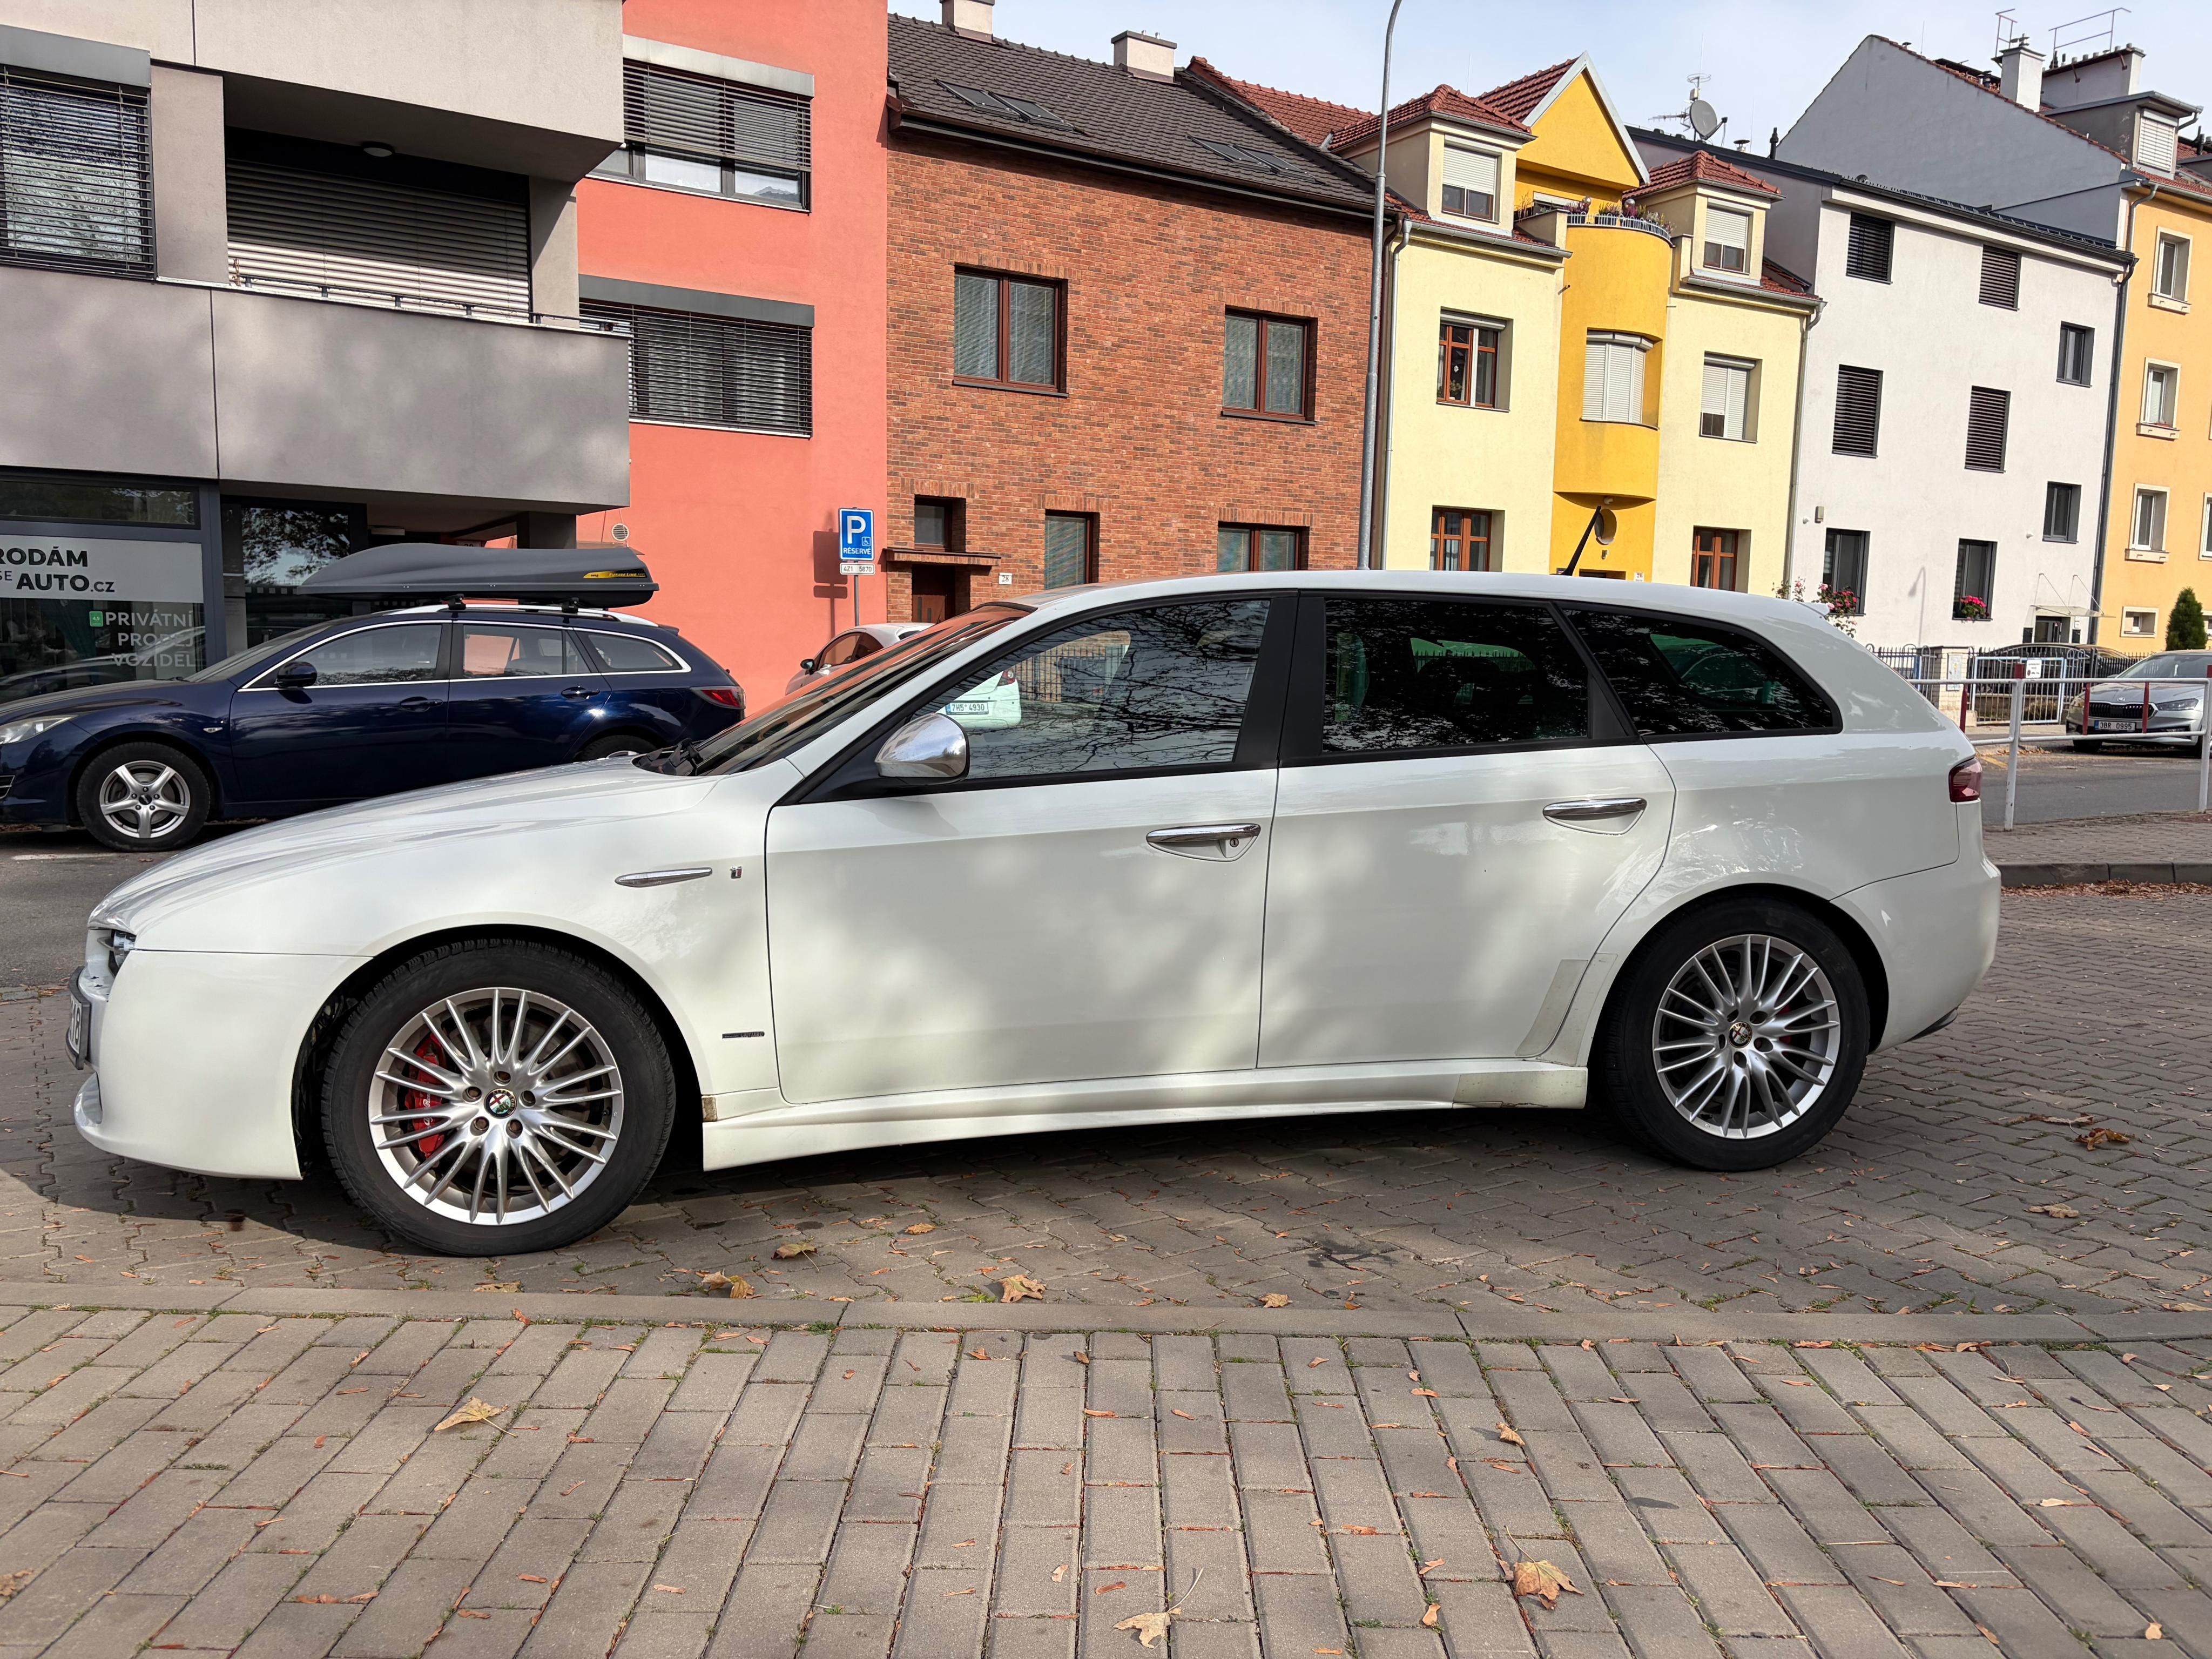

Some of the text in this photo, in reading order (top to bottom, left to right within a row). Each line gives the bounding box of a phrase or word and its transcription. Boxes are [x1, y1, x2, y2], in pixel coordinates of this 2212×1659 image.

[847, 515, 866, 544] P
[843, 547, 872, 555] RÉSERVÉ
[105, 609, 193, 627] PRIVÁTNÍ
[111, 652, 196, 666] VOZIDEL
